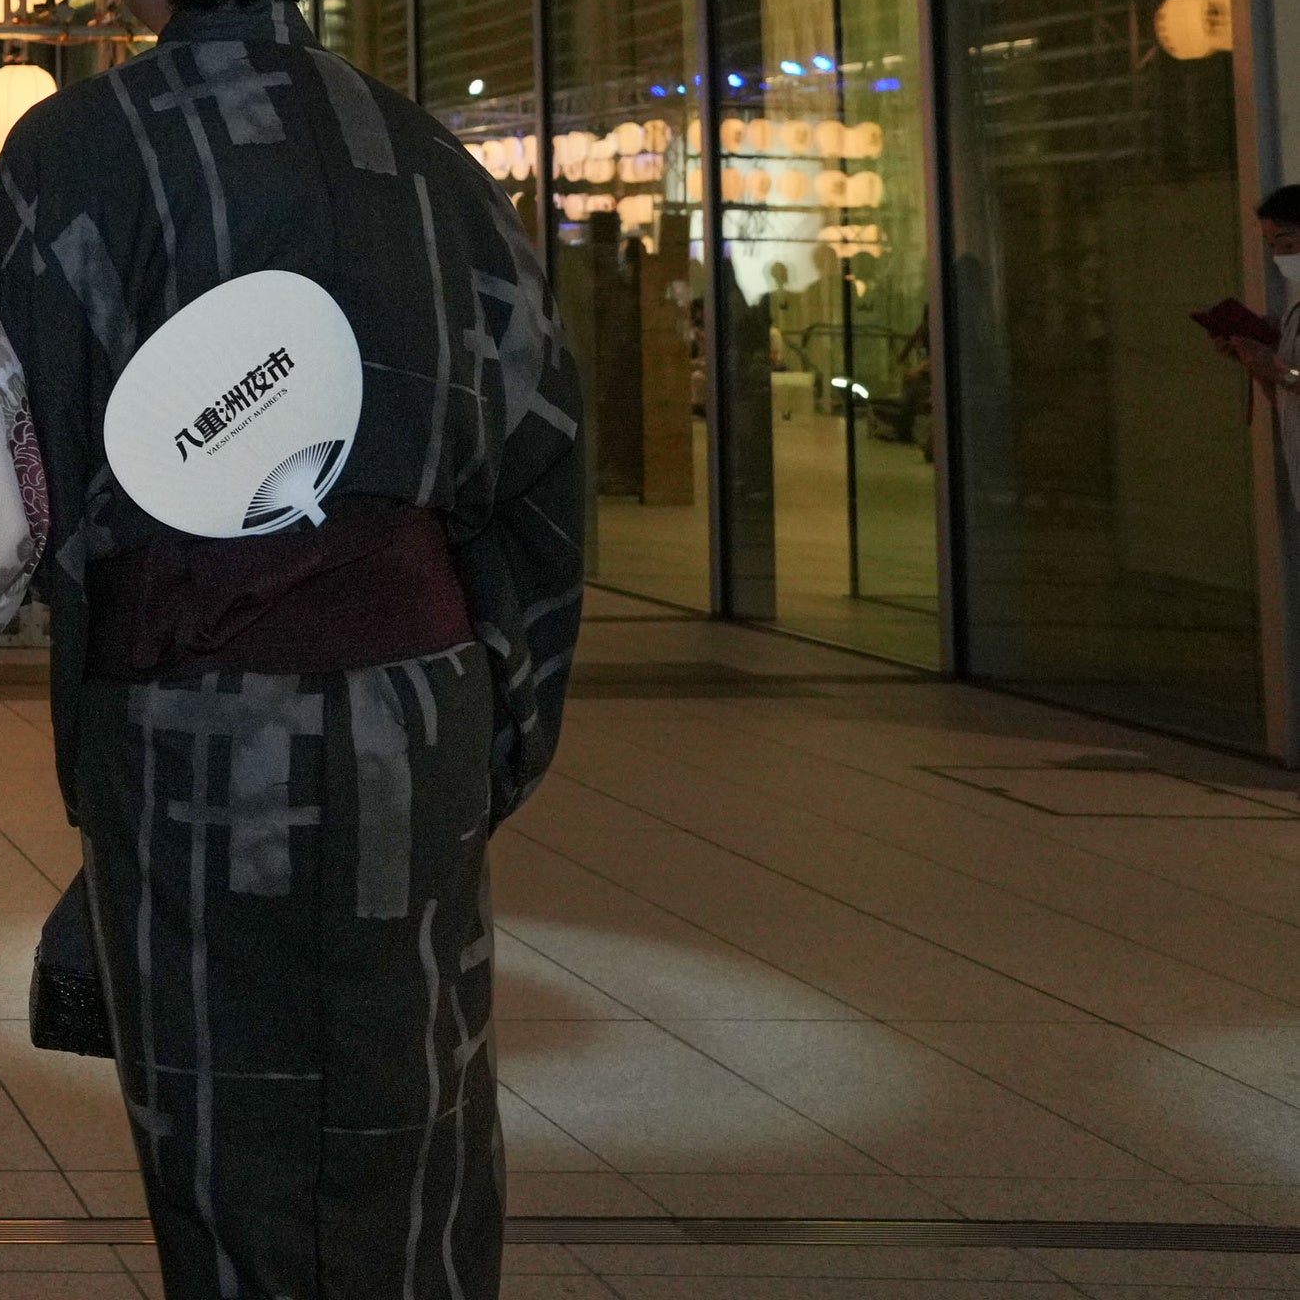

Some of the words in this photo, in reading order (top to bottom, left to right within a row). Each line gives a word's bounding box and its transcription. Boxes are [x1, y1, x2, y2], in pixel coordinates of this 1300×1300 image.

[174, 347, 295, 463] 八重洲夜市
[206, 436, 231, 456] YAESU
[230, 416, 253, 438] NIGHT
[254, 388, 288, 419] MARKETS
